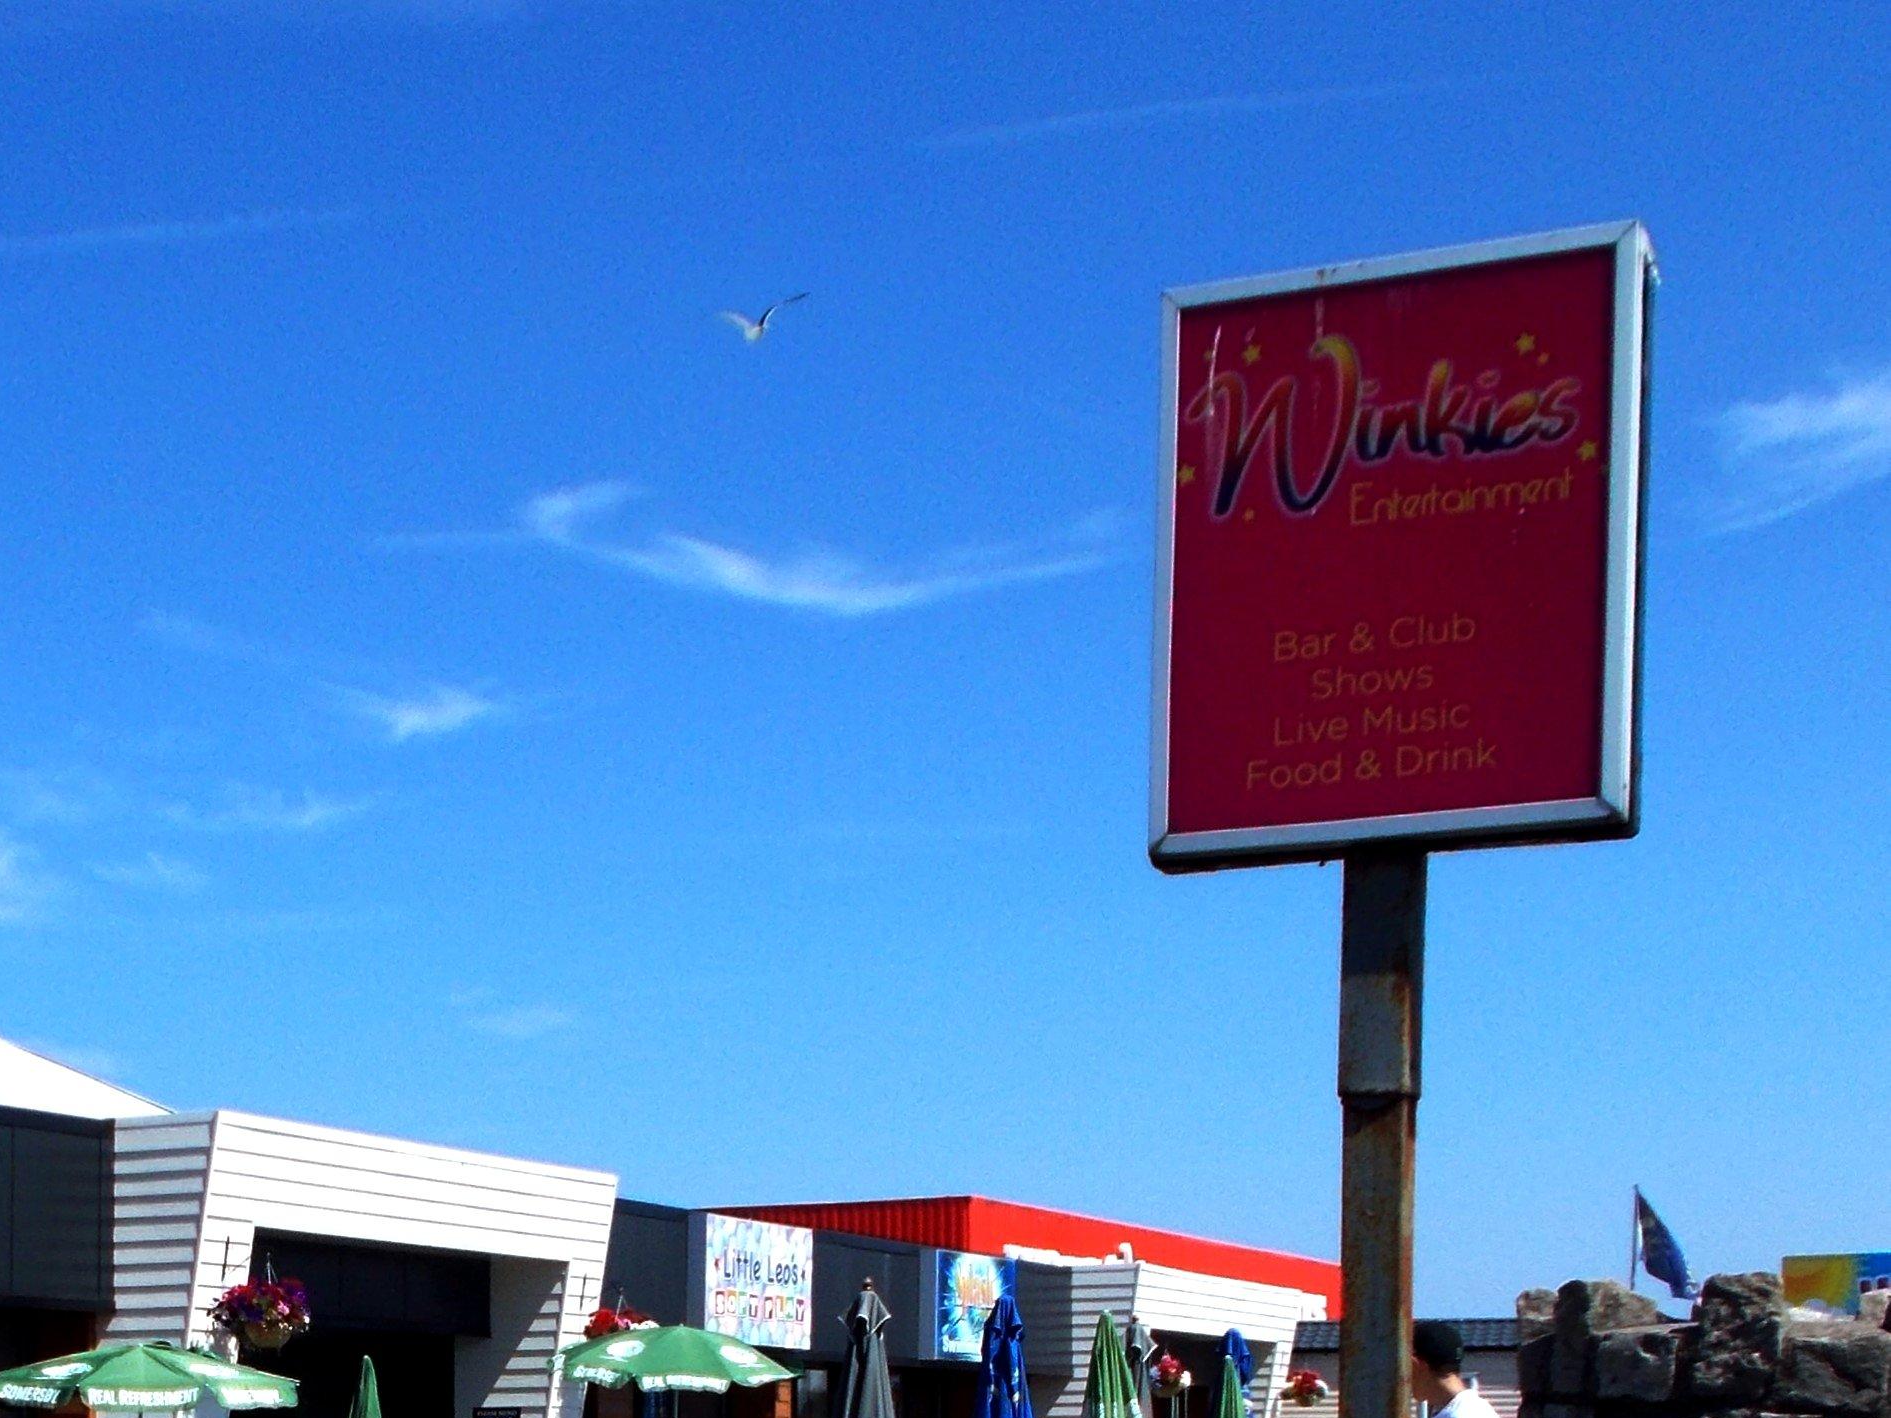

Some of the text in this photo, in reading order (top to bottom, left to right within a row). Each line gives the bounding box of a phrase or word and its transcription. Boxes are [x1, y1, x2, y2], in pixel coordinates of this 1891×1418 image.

[1350, 466, 1574, 526] Entertainment
[1273, 613, 1476, 663] Bar & Club
[1311, 664, 1433, 699] Shows
[1273, 700, 1470, 747] Live Music
[1246, 737, 1498, 790] Food & Drink
[723, 1247, 800, 1286] Little Leo's
